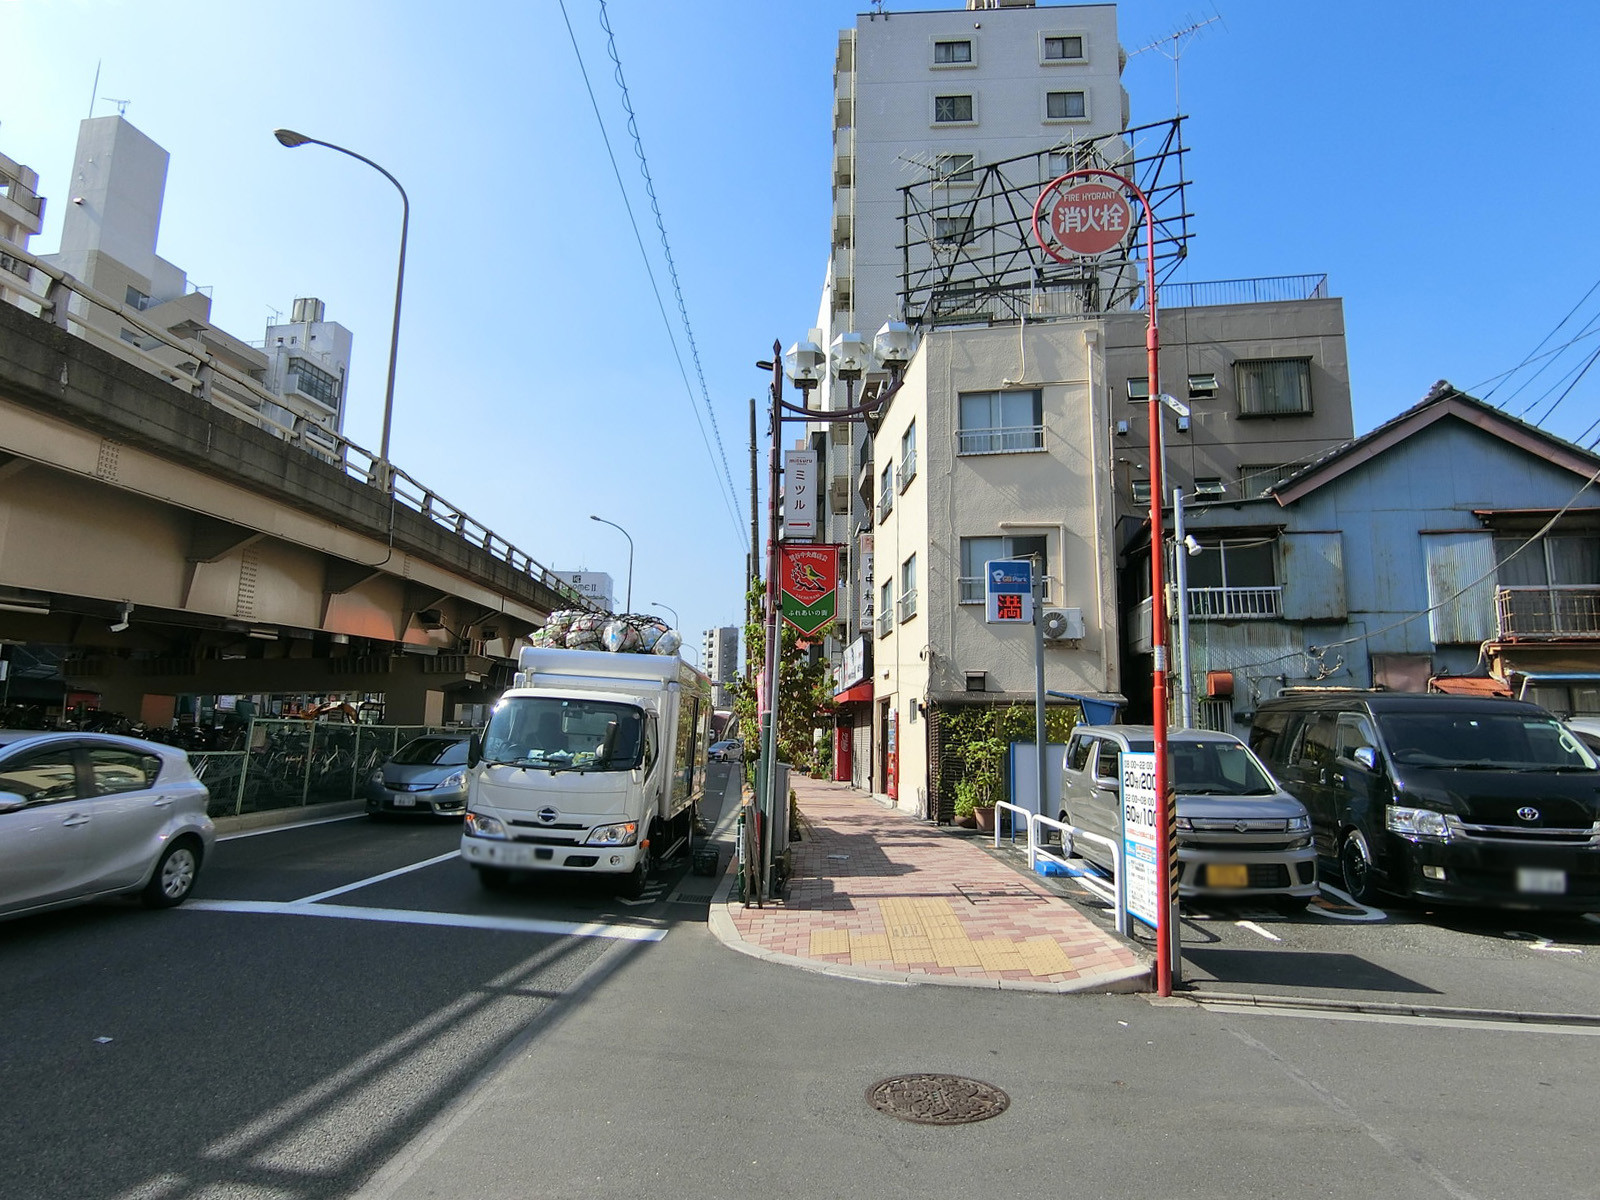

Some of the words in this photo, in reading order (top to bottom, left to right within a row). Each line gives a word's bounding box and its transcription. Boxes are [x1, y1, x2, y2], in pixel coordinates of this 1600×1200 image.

[1064, 192, 1080, 202] FIRE
[1082, 191, 1117, 201] HYDRANT
[1059, 203, 1124, 234] 消火栓
[794, 470, 806, 510] ミツル
[998, 594, 1022, 619] 満
